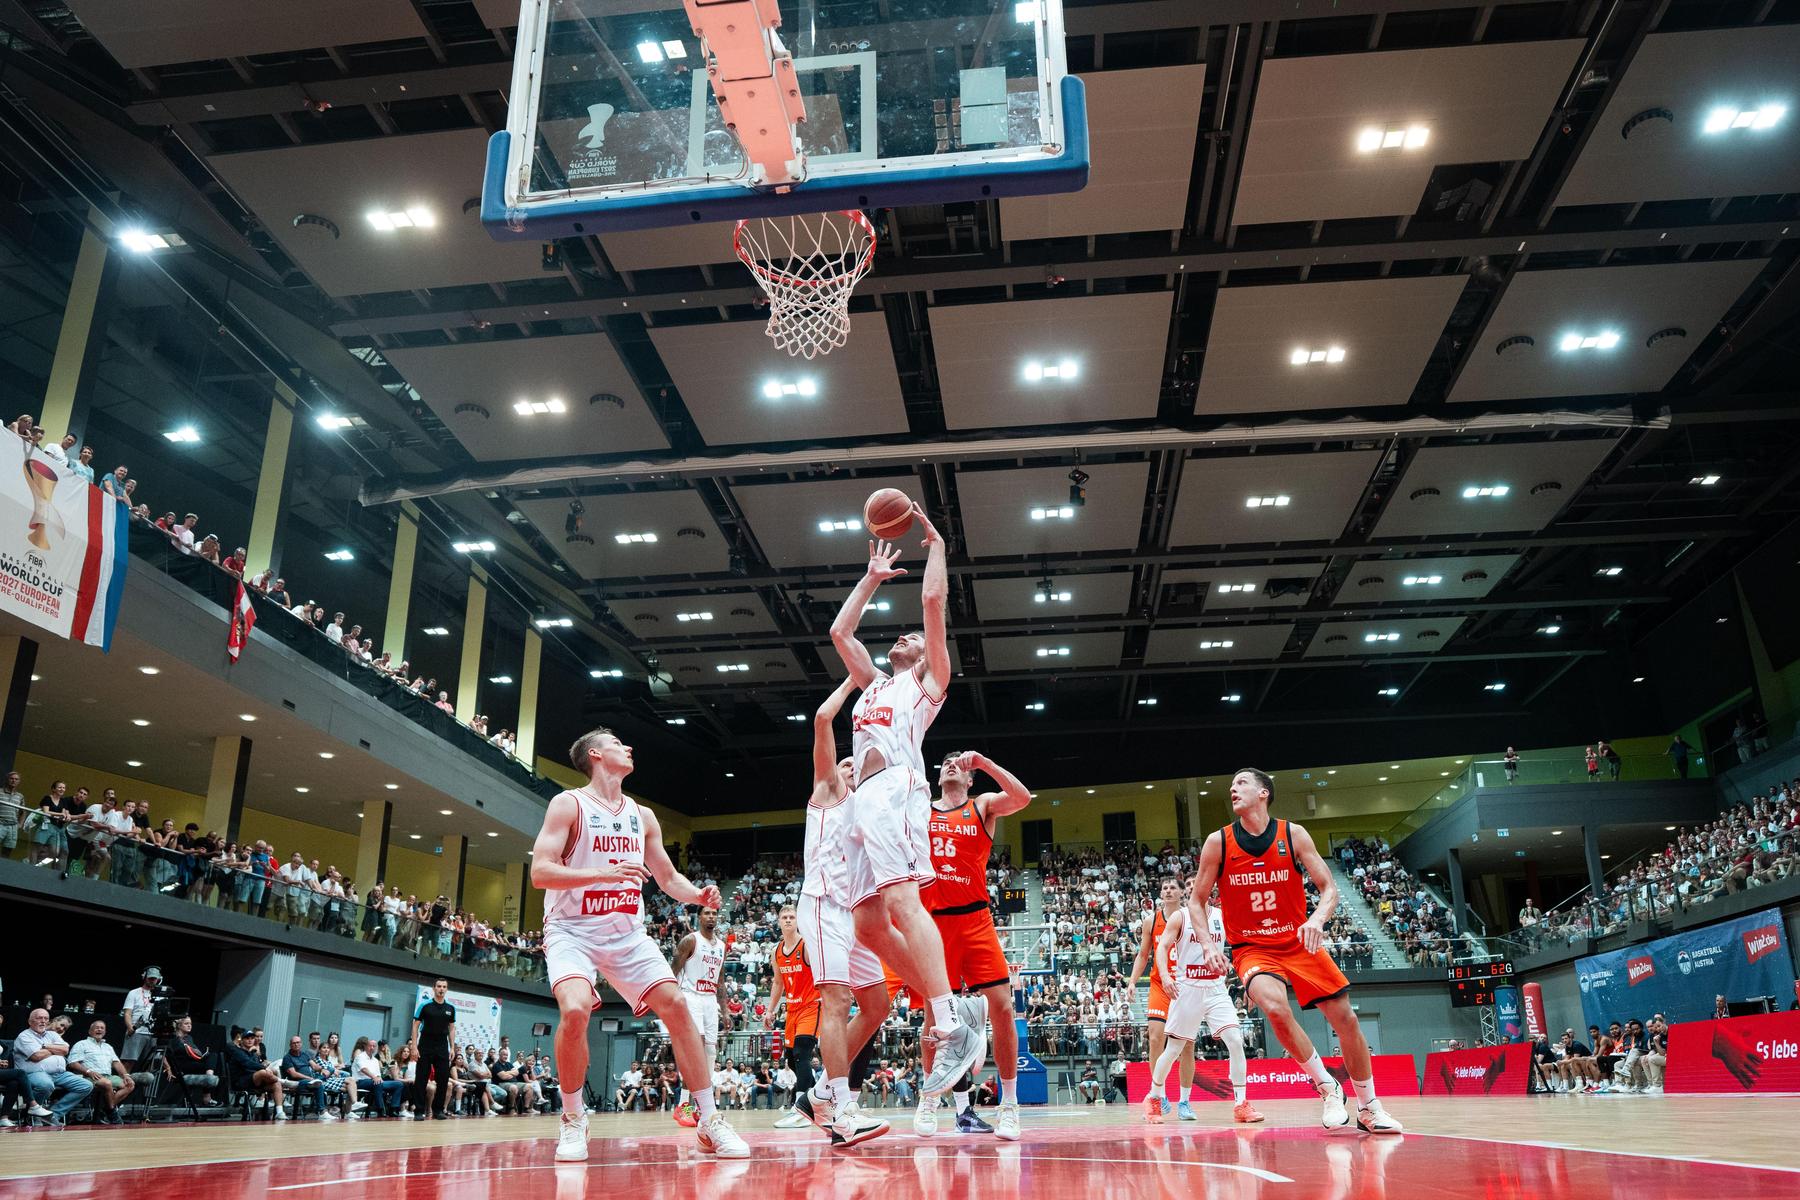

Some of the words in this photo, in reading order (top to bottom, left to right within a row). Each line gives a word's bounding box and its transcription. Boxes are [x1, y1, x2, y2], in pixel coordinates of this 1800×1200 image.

[2, 553, 64, 587] BASKETBALL
[28, 554, 43, 568] FIBA
[0, 560, 40, 587] WORLD
[42, 581, 63, 597] CUP
[1, 586, 59, 619] RE-QUALIFIERS
[20, 583, 60, 611] EUROPEAN
[592, 835, 642, 853] AUSTRIA
[932, 837, 956, 858] 26
[1229, 869, 1290, 886] NEDERLAND
[1250, 890, 1277, 912] 22
[1691, 945, 1722, 958] BASKETBALL
[1747, 934, 1777, 955] win2day
[1448, 968, 1455, 979] H
[1455, 966, 1470, 978] 81
[1491, 963, 1505, 975] 62
[1505, 963, 1513, 974] G
[1628, 962, 1652, 979] win2day
[1694, 957, 1714, 968] AUSTRIA
[1772, 1039, 1798, 1059] lebe
[1246, 1073, 1268, 1083] ebe
[1269, 1072, 1313, 1084] Fairplay
